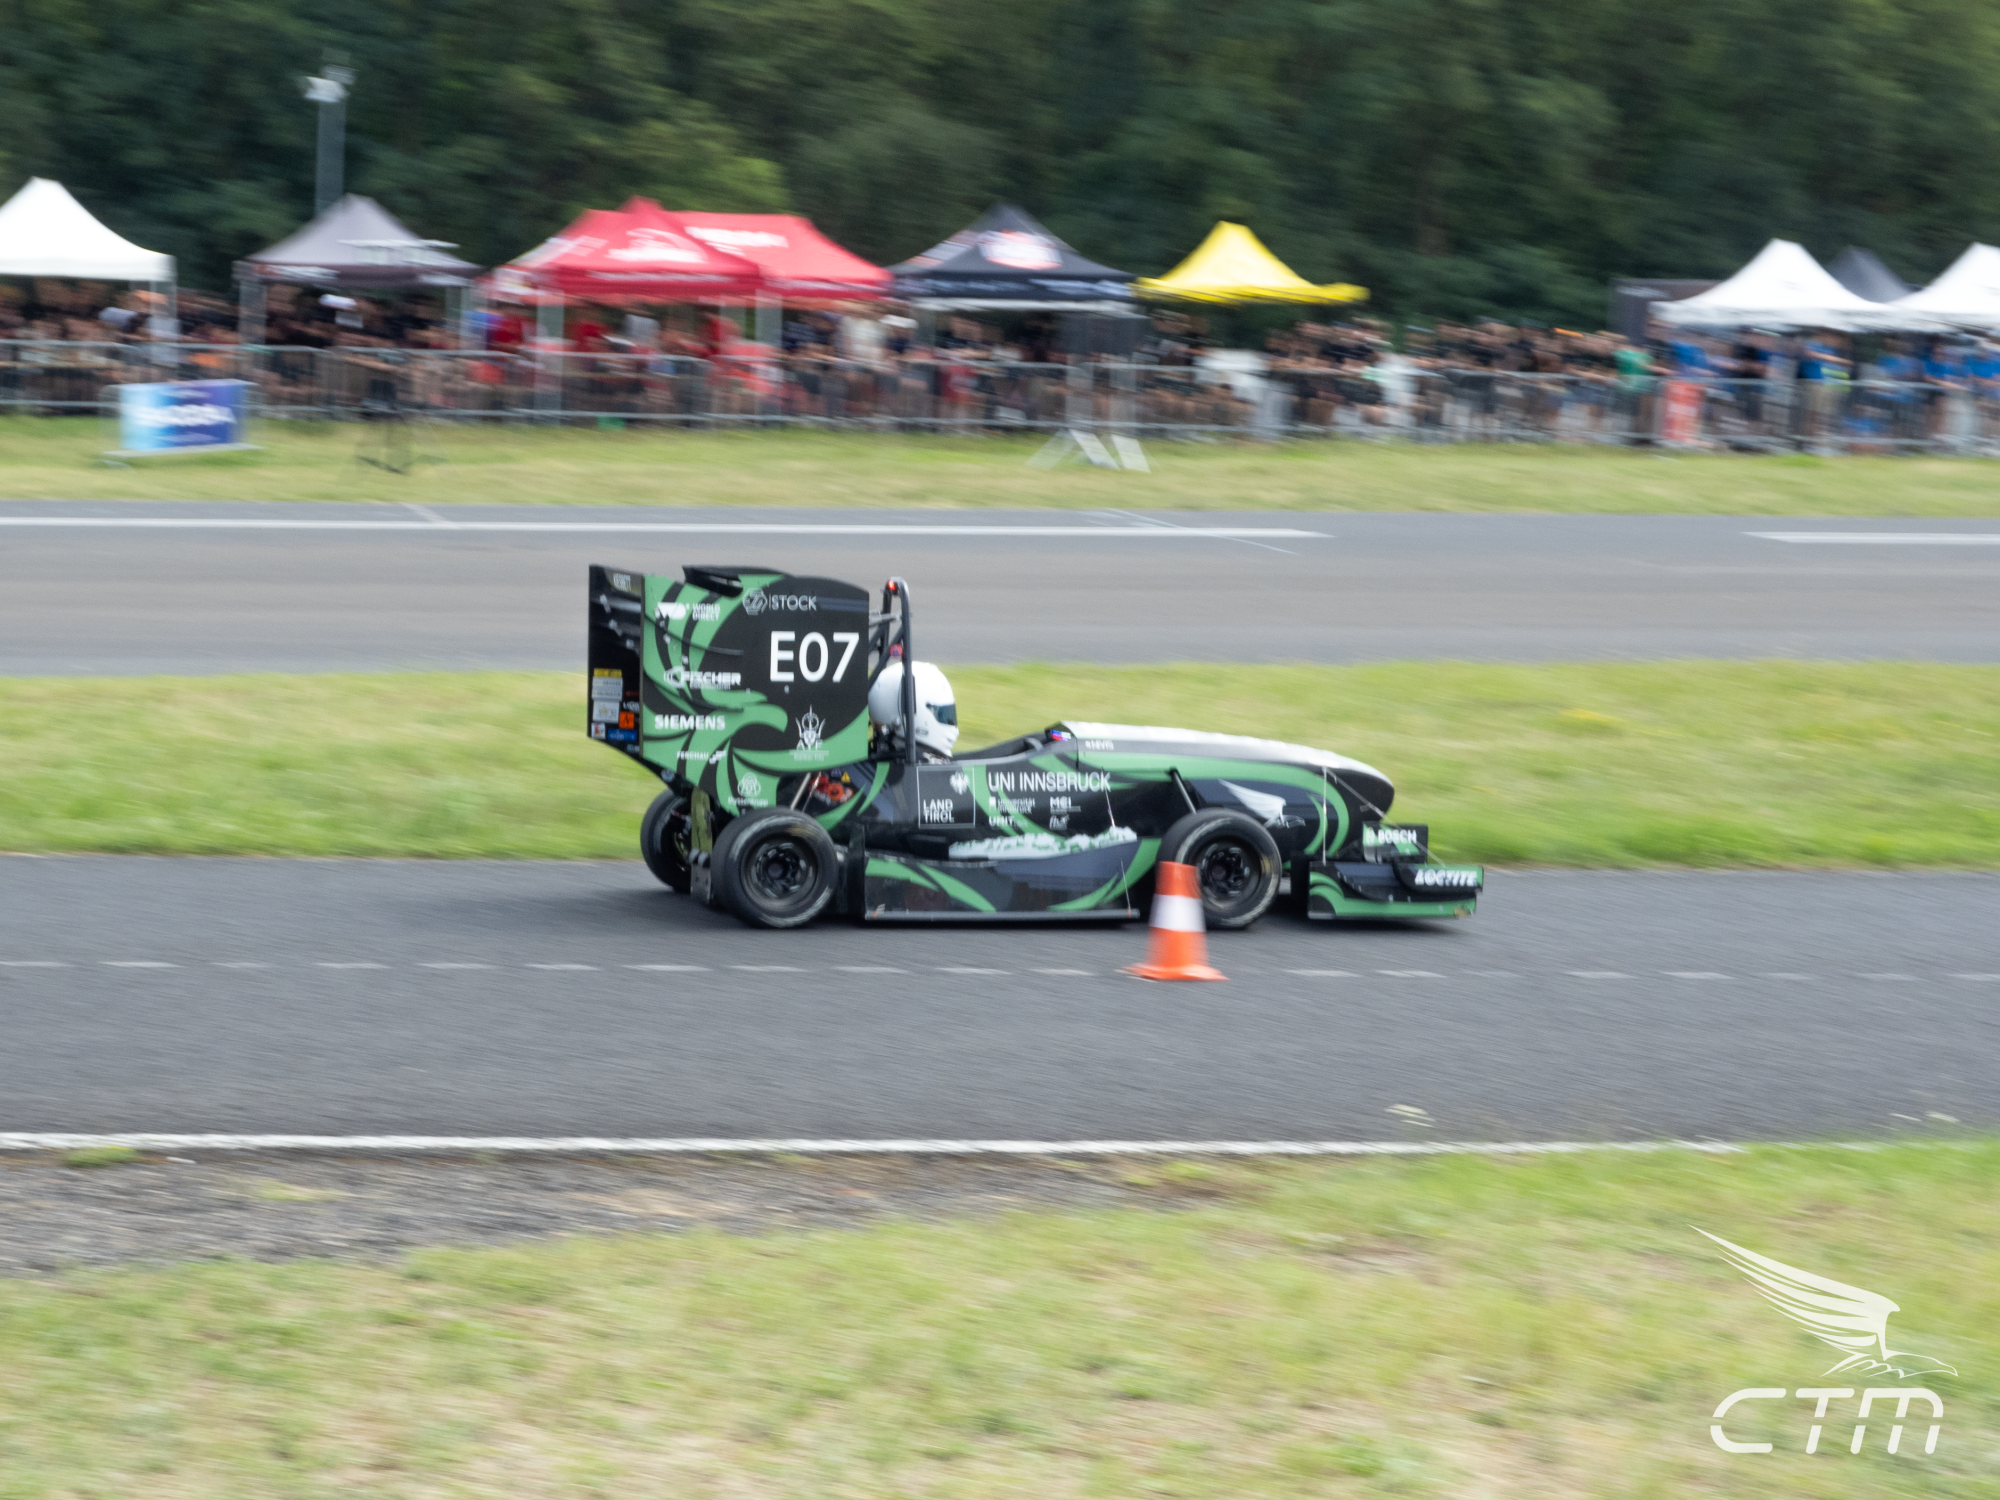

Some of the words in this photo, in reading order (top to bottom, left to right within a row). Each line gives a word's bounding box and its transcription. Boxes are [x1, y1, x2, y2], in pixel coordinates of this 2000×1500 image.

[692, 603, 720, 612] WORLD
[771, 594, 817, 611] STOCK
[770, 631, 859, 683] E07
[654, 714, 726, 731] SIEMENS
[988, 771, 1015, 792] UNI
[1019, 771, 1111, 793] INNSBRUCK
[923, 798, 954, 811] LAND
[923, 810, 955, 823] TIROL
[1377, 829, 1418, 844] BOSCH
[1414, 869, 1478, 886] LOCTITE
